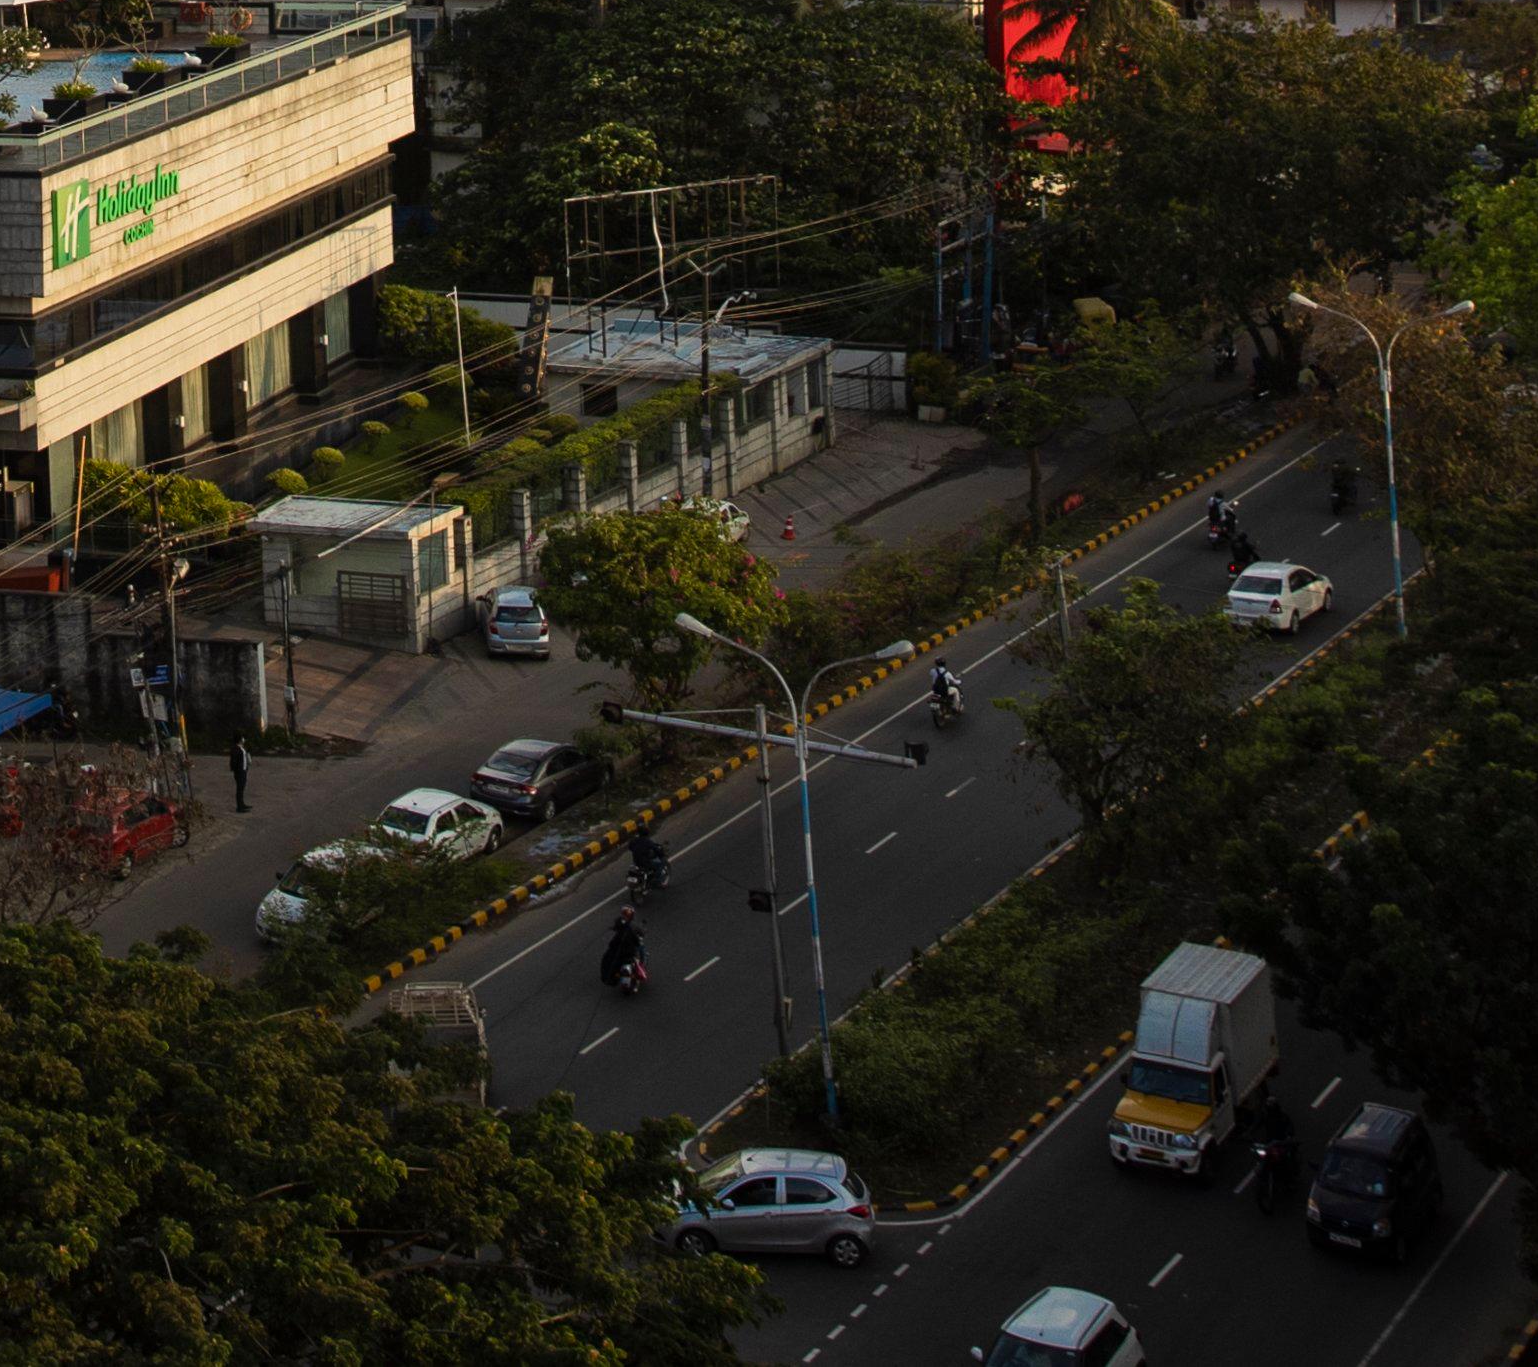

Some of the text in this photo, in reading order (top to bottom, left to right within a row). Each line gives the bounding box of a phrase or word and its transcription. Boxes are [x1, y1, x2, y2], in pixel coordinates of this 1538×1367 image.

[97, 163, 180, 226] Holiday Inn
[124, 218, 155, 246] COCHIN
